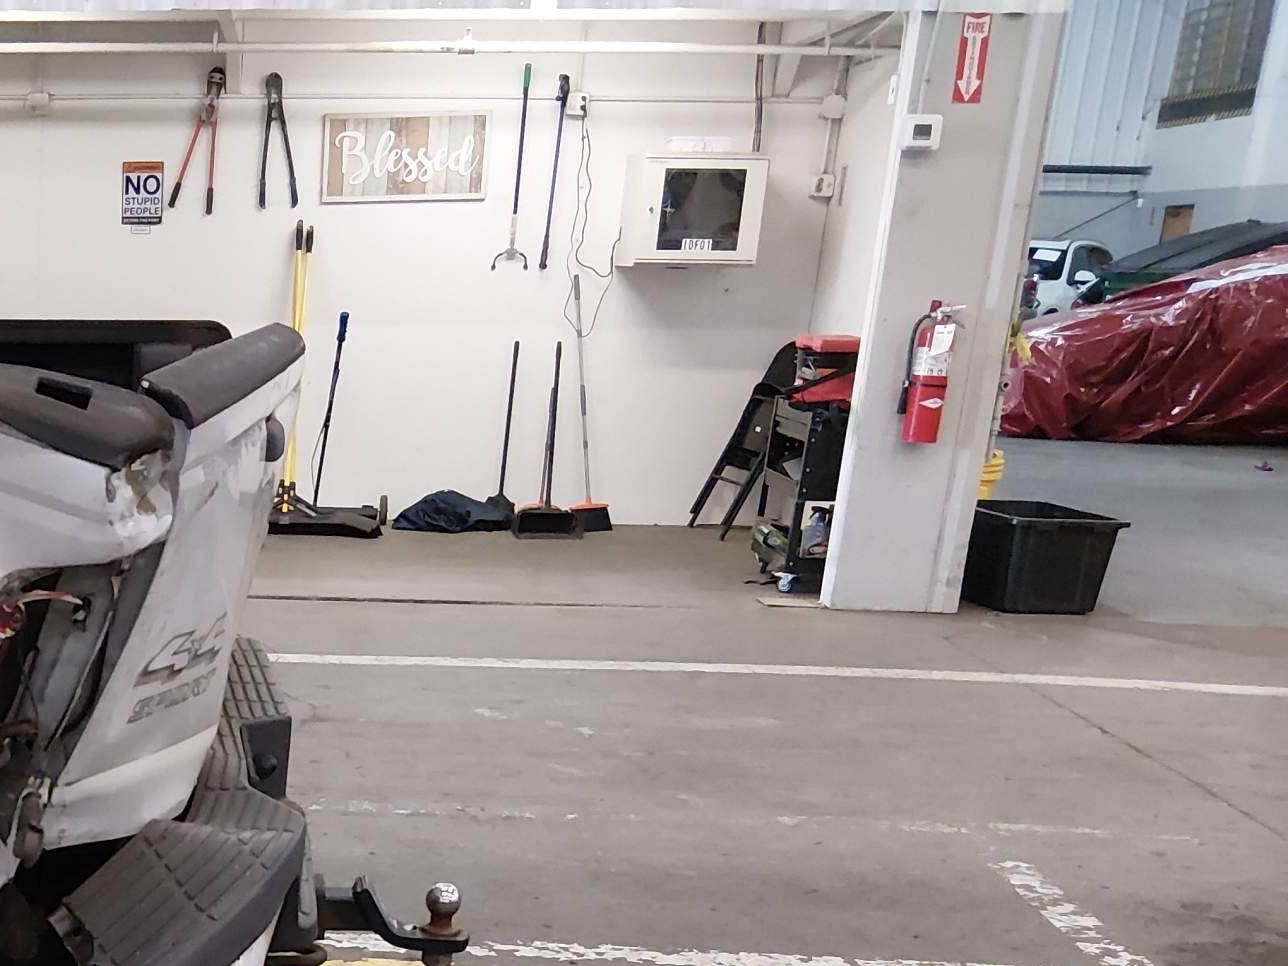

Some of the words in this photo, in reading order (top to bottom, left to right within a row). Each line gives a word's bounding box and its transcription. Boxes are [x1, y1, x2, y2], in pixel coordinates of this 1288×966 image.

[966, 22, 986, 33] FIRE
[335, 130, 479, 185] Blessed
[125, 174, 161, 195] NO
[124, 197, 160, 206] STUPID
[124, 207, 160, 216] PEOPLE
